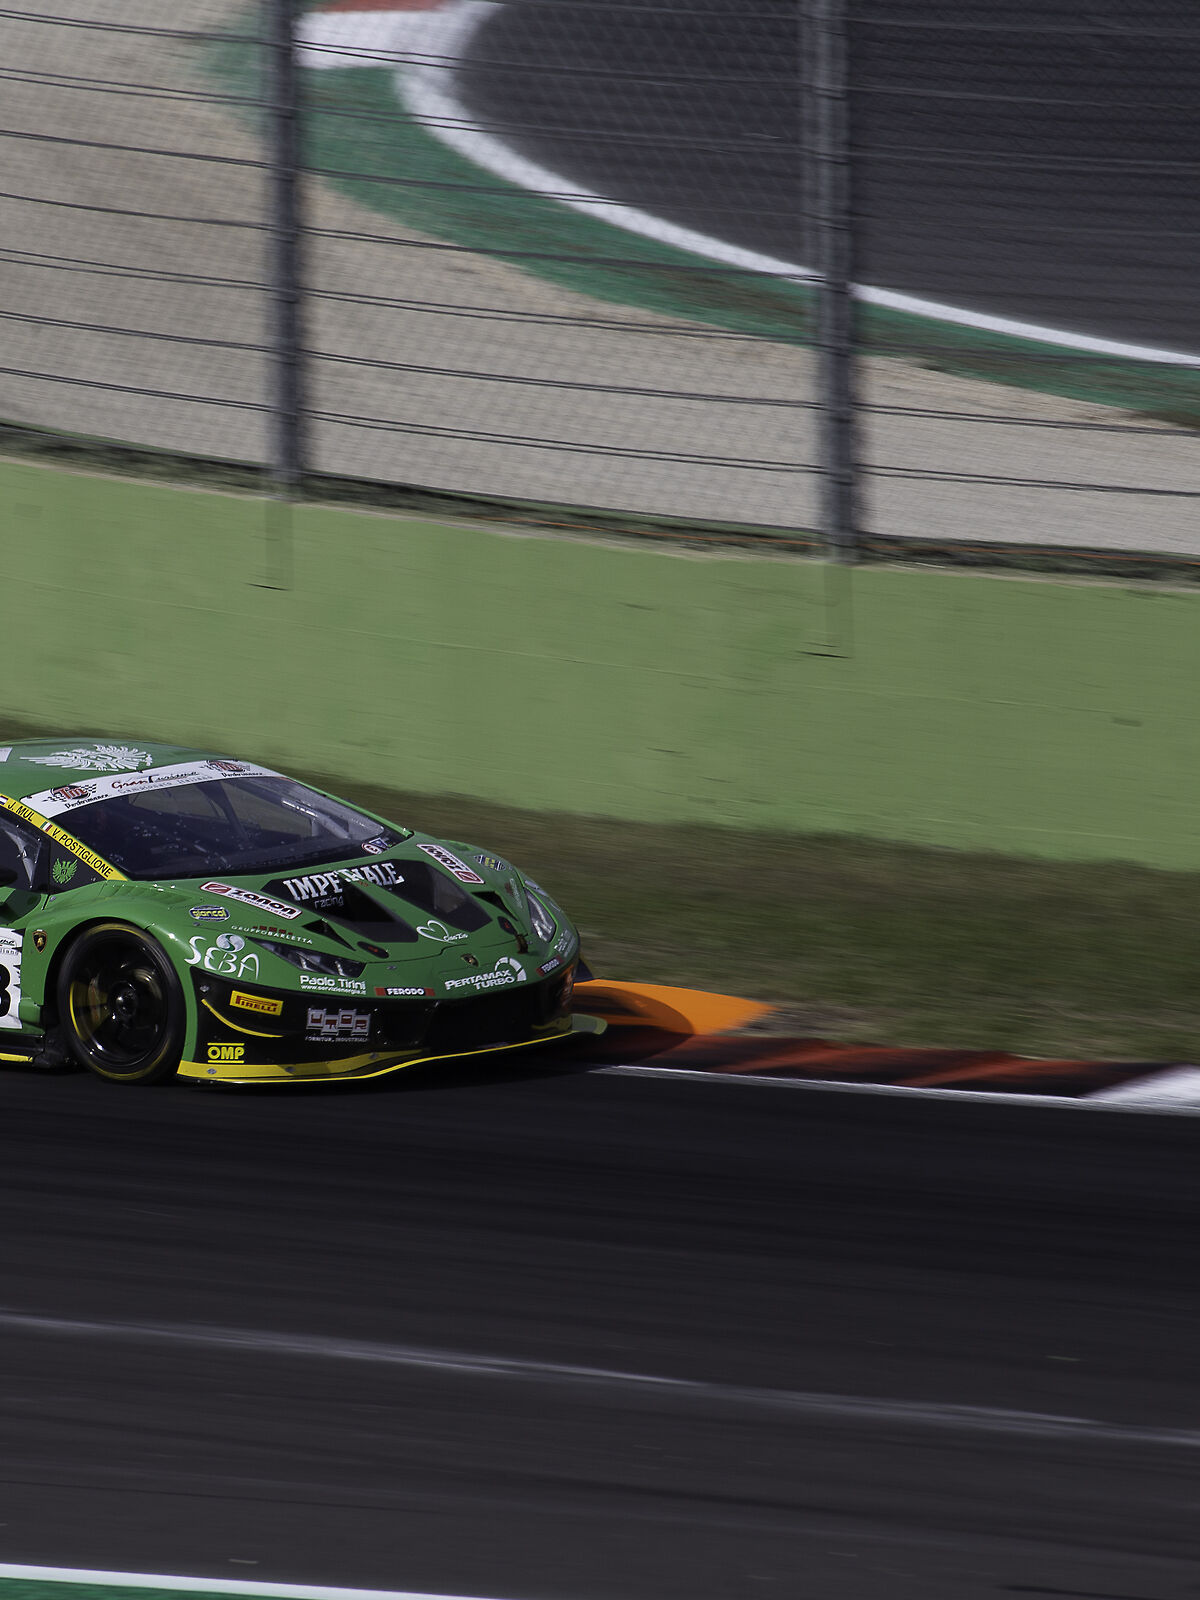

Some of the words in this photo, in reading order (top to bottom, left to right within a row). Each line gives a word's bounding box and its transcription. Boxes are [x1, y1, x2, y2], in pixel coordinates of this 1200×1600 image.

[6, 802, 15, 811] J.
[16, 804, 35, 821] MUL
[52, 828, 60, 838] V.
[58, 834, 114, 878] POSTIGLIONE
[231, 888, 297, 915] zanon
[314, 895, 344, 909] racing
[184, 936, 259, 980] SEBA
[300, 975, 335, 987] Paolo
[337, 978, 366, 990] Tirini
[444, 969, 511, 990] PERTAMAX
[473, 976, 515, 990] TURBO
[386, 988, 425, 996] FERODO
[235, 995, 278, 1012] PIRELLI
[207, 1046, 245, 1059] OMP
